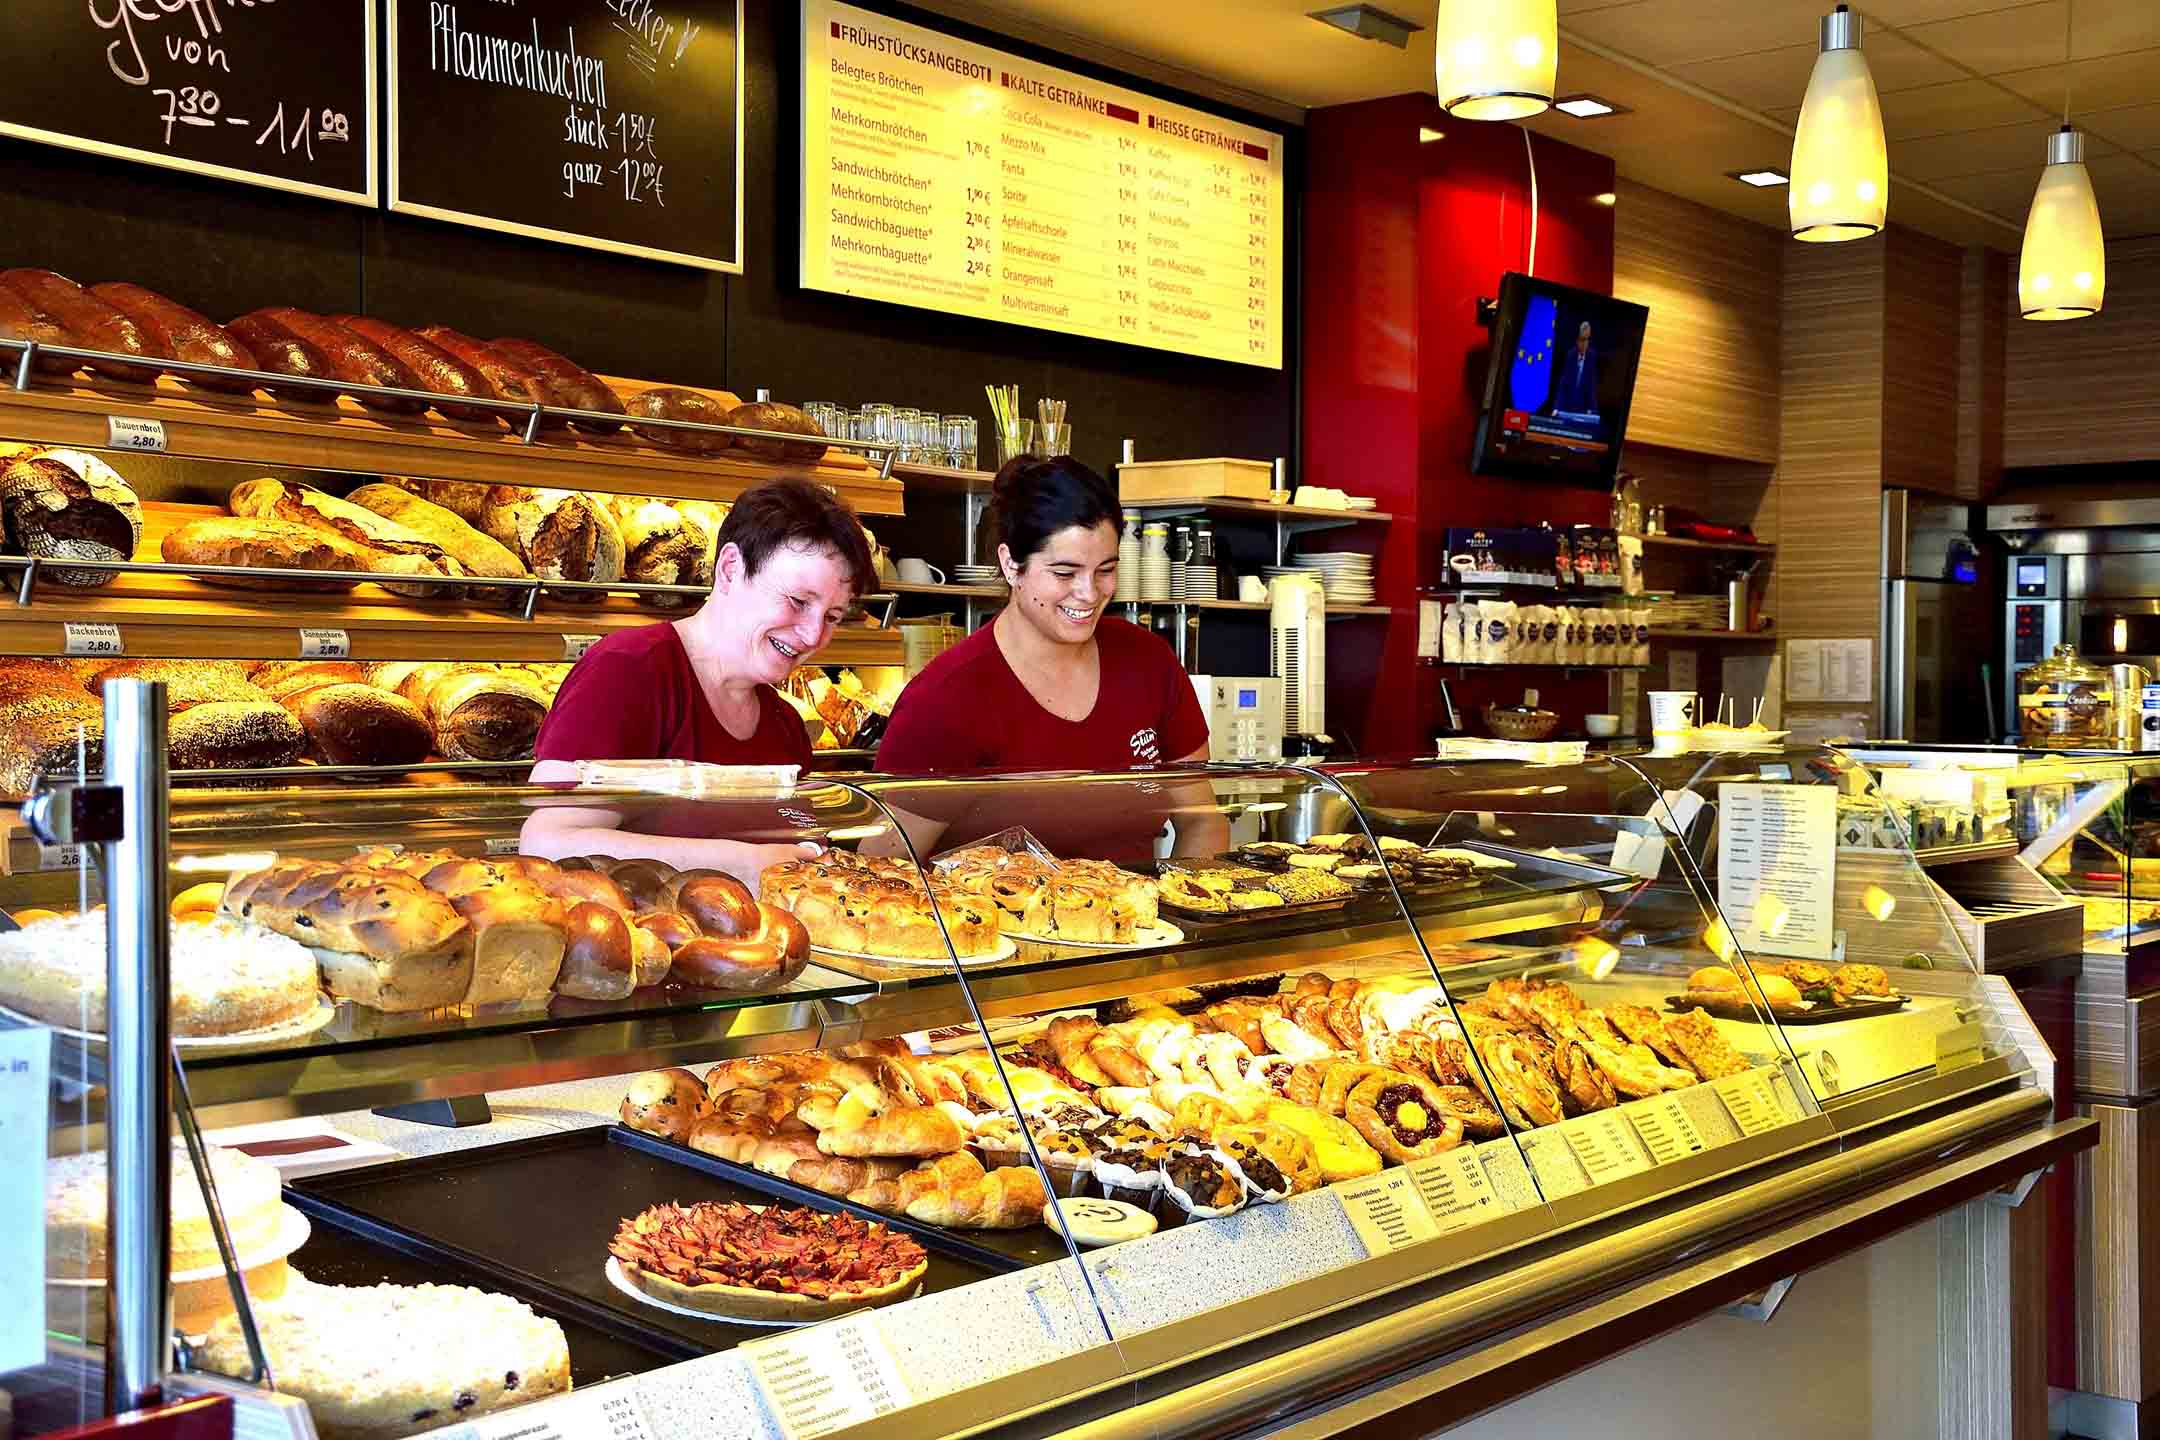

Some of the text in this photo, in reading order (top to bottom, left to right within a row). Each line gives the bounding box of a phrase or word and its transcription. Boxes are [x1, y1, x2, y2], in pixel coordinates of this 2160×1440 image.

[166, 35, 230, 73] von
[430, 1, 608, 110] Pflaumenkuchen
[841, 24, 987, 82] FRÜHSTÜCKSANGEBOT
[831, 58, 876, 84] Belegtes
[878, 70, 925, 97] Brötchen
[1009, 73, 1106, 116] KALTE GETRÄNKE
[831, 106, 928, 143] Mehrkornbrötchen
[1155, 116, 1244, 155] HEISSE GETRÄNKE
[562, 161, 604, 199] ganz
[114, 419, 161, 433] Bauernbrot
[133, 435, 155, 448] 2,80
[87, 641, 111, 653] 2,80
